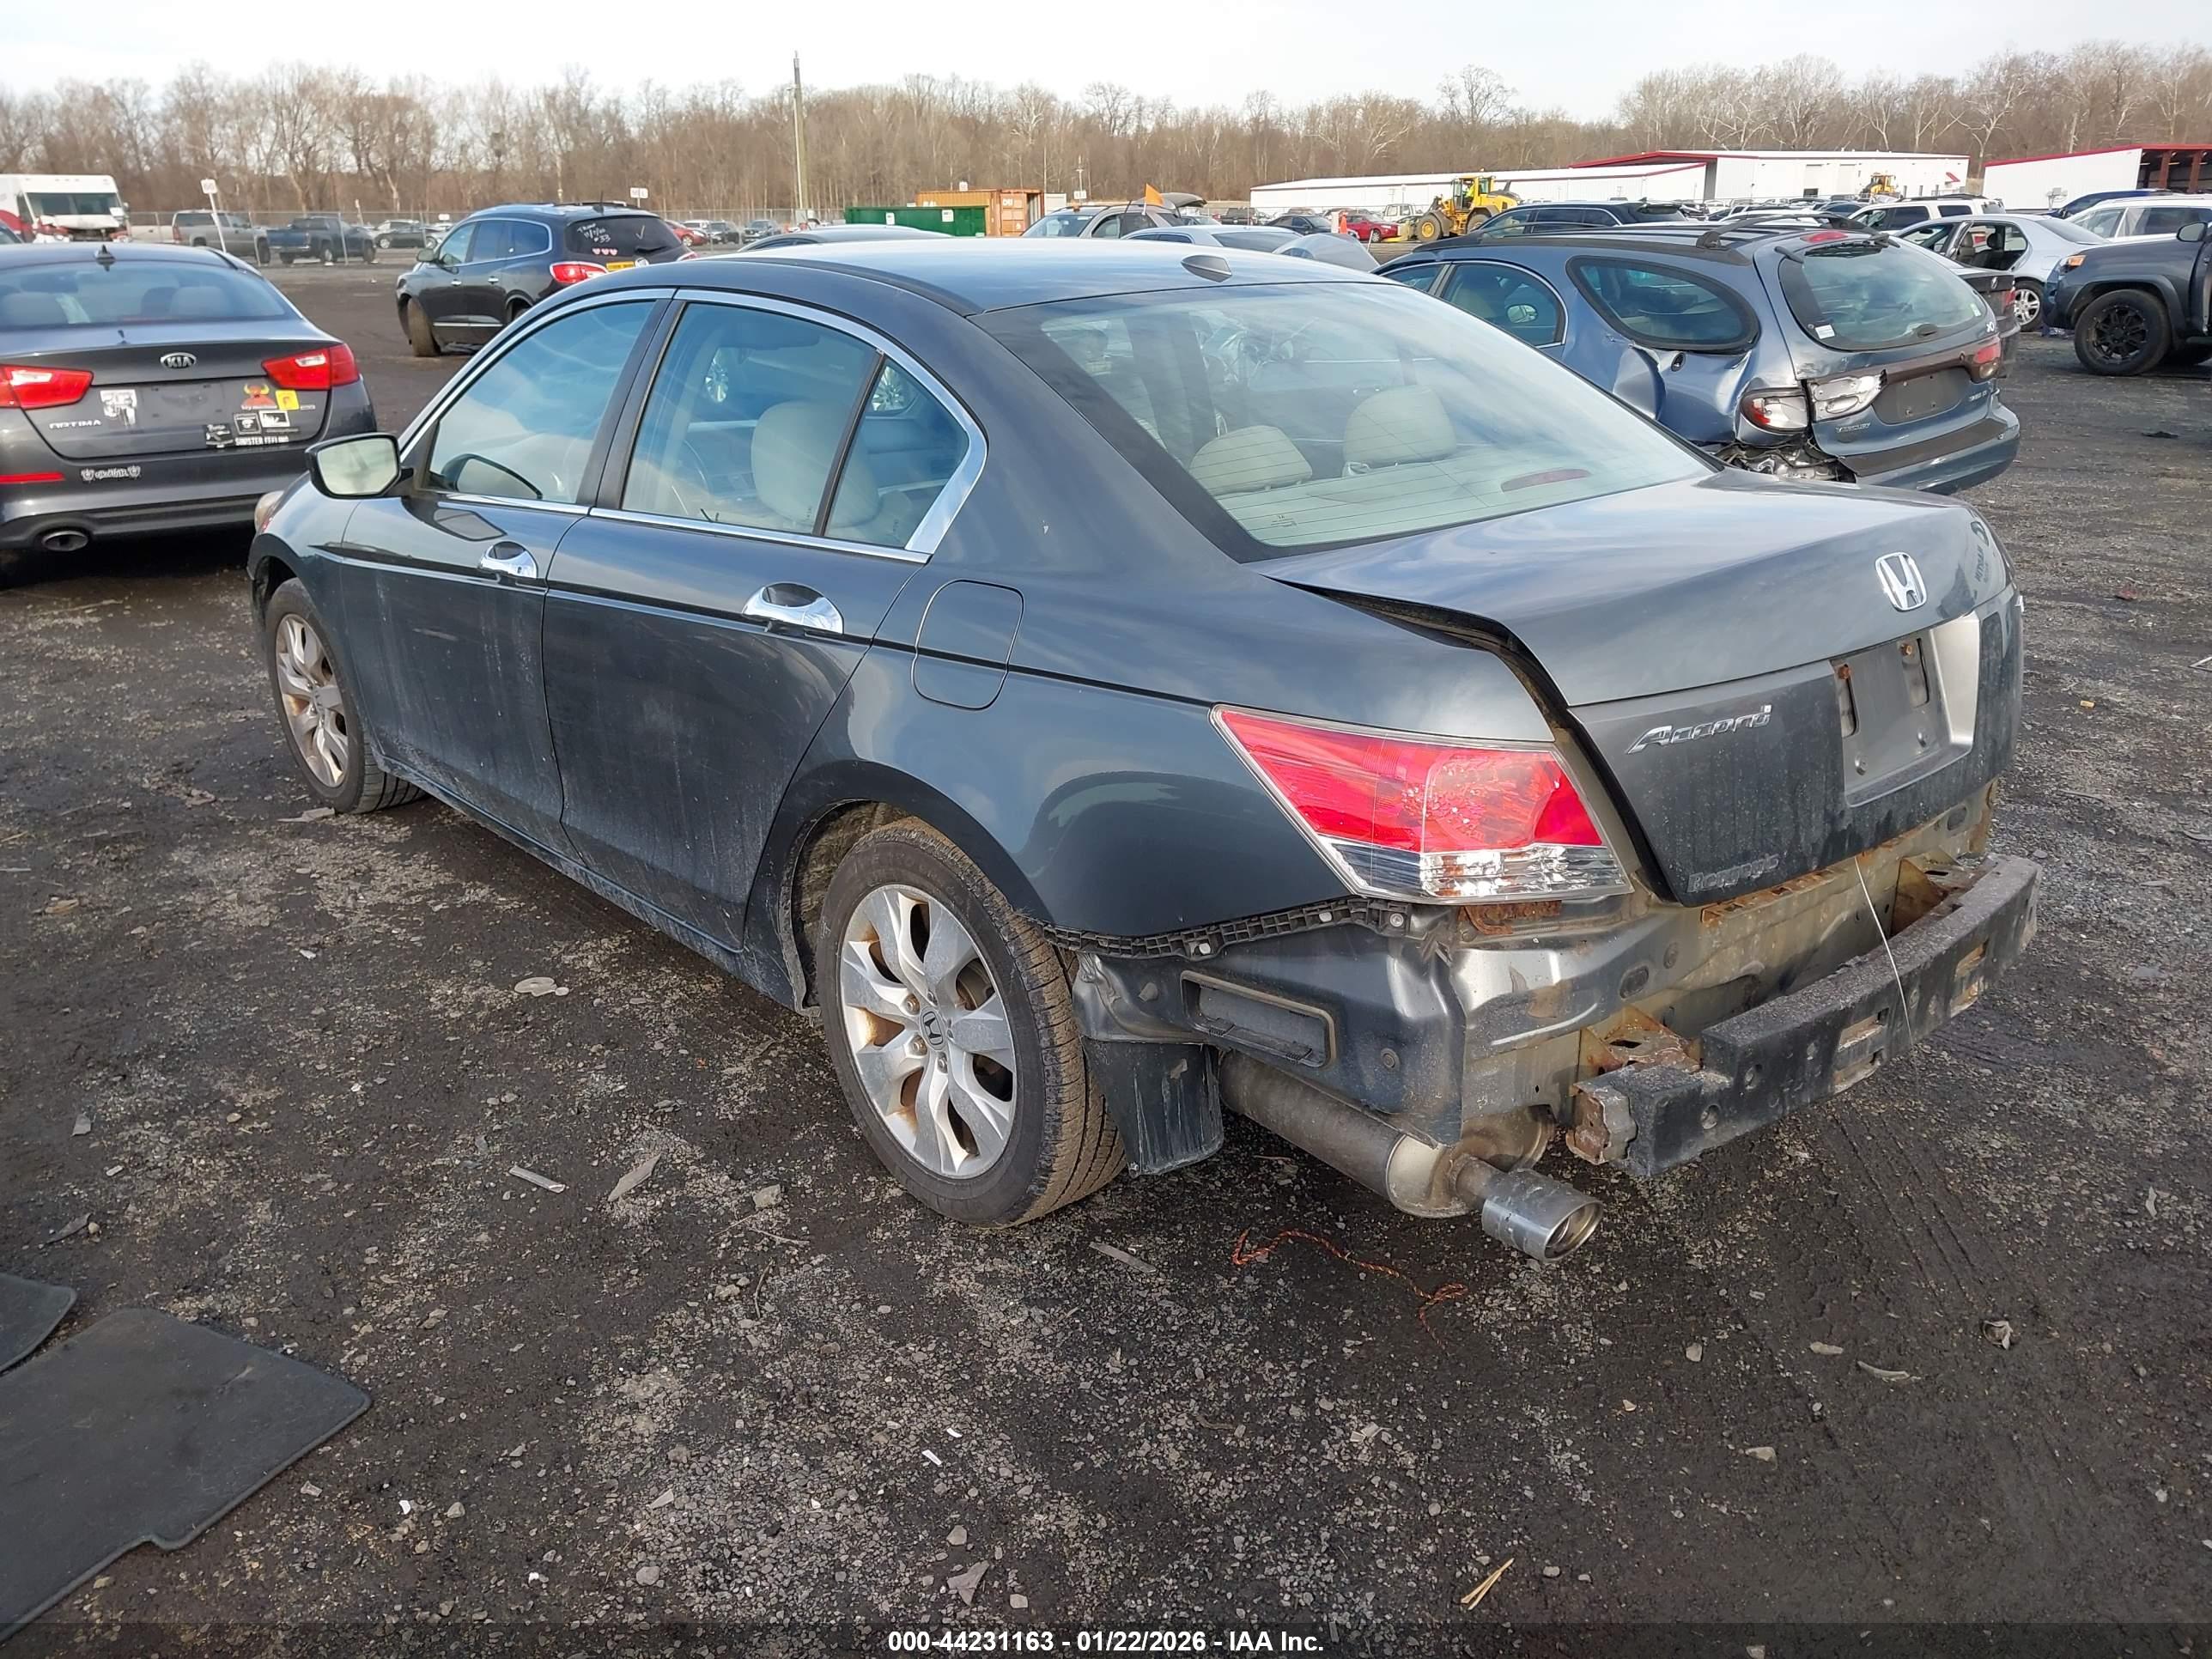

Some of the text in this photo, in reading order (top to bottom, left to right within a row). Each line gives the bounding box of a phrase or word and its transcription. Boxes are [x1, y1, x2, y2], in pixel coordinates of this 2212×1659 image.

[167, 356, 192, 368] KIA
[49, 419, 101, 429] OPTIMA
[1625, 704, 1772, 755] Accord
